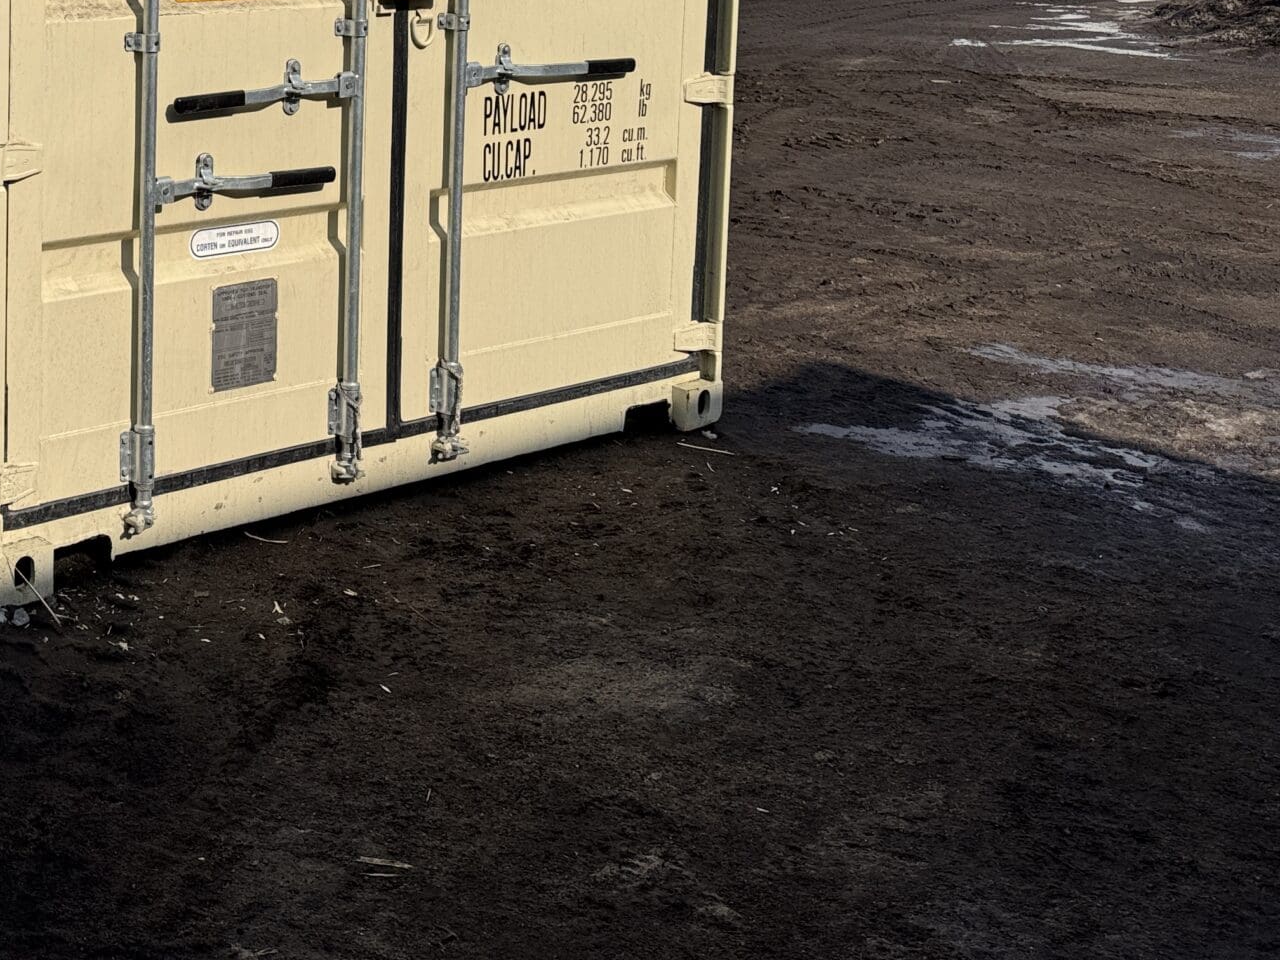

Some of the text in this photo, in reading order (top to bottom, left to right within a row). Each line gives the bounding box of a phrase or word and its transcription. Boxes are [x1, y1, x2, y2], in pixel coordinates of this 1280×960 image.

[639, 79, 652, 101] kg
[483, 90, 547, 137] PAYLOAD
[638, 99, 648, 118] lb
[585, 126, 649, 147] 33.2 cu.m.
[483, 137, 536, 182] CU.CAP.
[579, 142, 647, 168] 1,170 cu.ft.
[196, 241, 218, 252] CORTEN
[227, 235, 261, 248] EQUIVALENT
